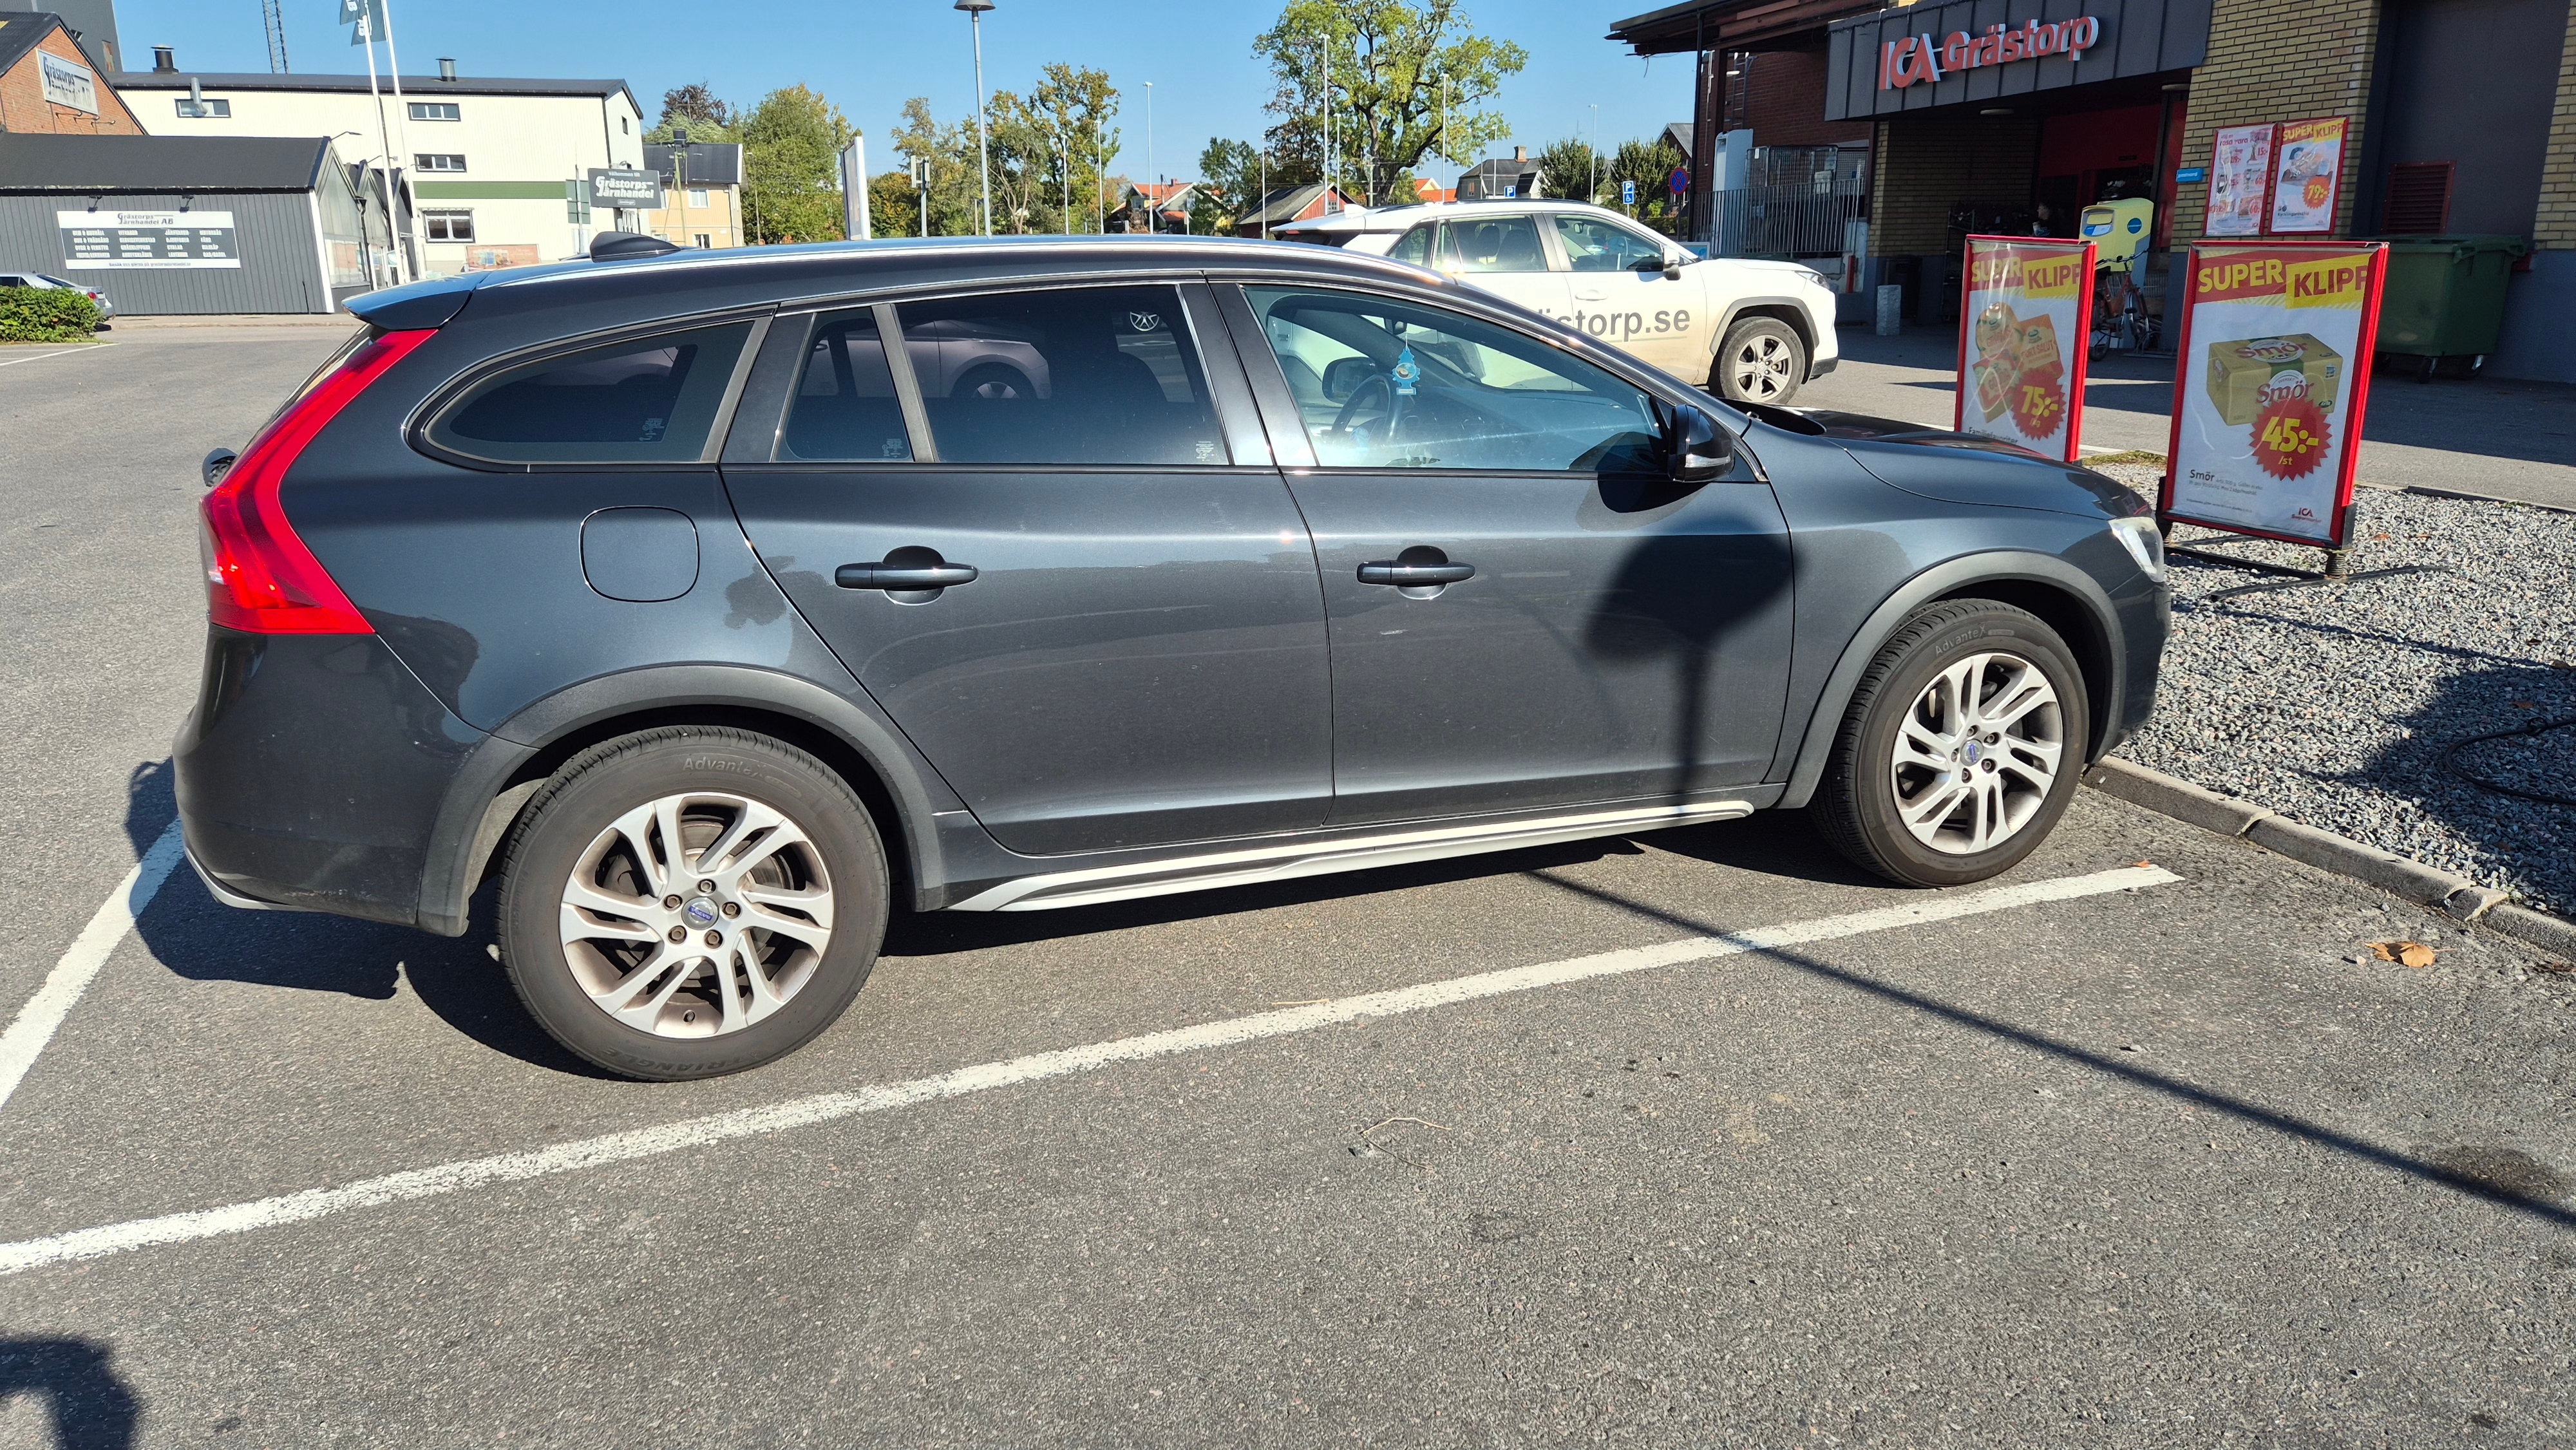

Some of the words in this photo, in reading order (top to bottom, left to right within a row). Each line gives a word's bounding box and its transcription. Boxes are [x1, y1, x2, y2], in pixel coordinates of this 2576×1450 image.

[1879, 33, 1940, 89] ICA
[1942, 16, 2099, 72] Grästorp
[2283, 124, 2313, 141] SUPER
[2316, 123, 2343, 138] KLIPP
[595, 176, 647, 190] Grästorps
[2308, 184, 2329, 200] 79:-
[596, 187, 654, 198] Järnhandel
[1971, 257, 2022, 283] SUPER
[2028, 263, 2081, 290] KLIPP
[2198, 258, 2284, 293] SUPER
[2294, 265, 2368, 298] KLIPP
[2235, 343, 2308, 359] Smör
[2021, 385, 2058, 417] 75:-
[2256, 380, 2315, 404] Smör
[2262, 416, 2318, 454] 45:-
[2278, 455, 2293, 465] /st
[2190, 469, 2215, 482] Smör
[2298, 507, 2313, 518] ICA
[1935, 624, 1986, 657] AdvanteX
[683, 756, 766, 778] AdvanteX
[691, 907, 711, 919] VOLVO
